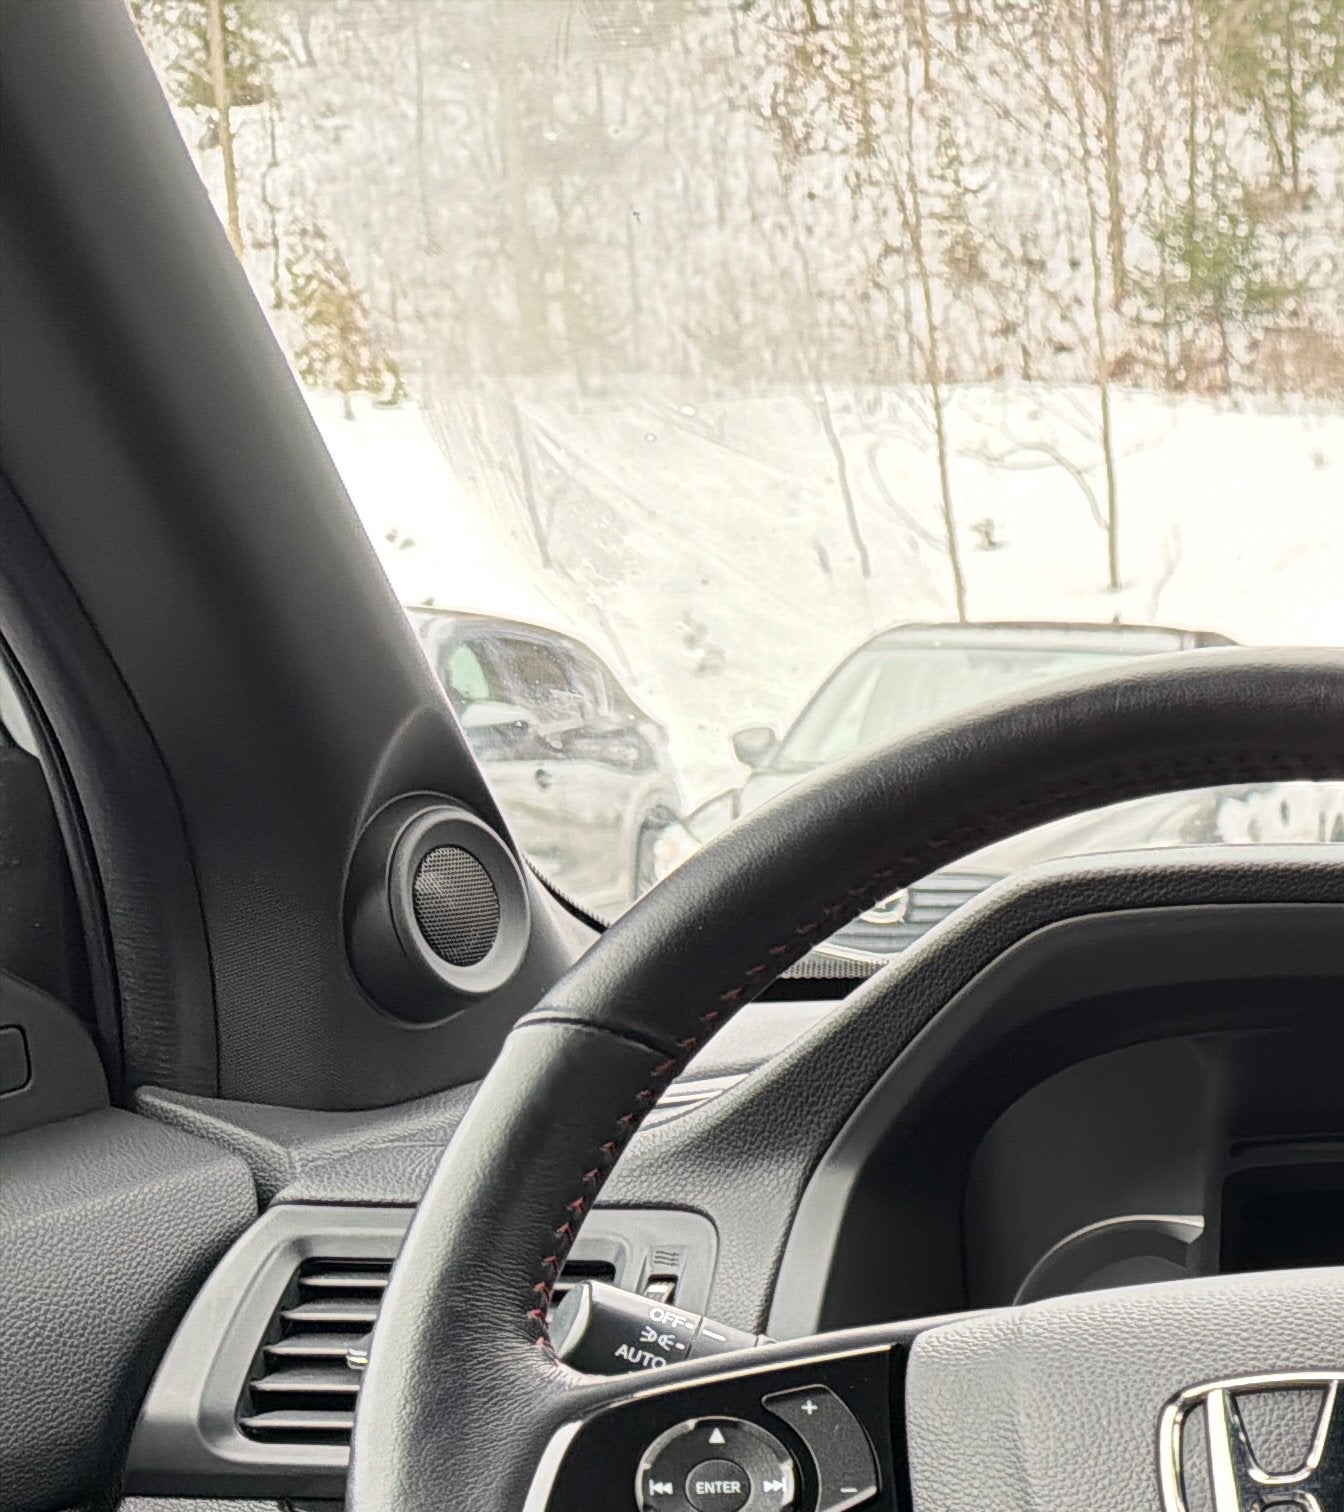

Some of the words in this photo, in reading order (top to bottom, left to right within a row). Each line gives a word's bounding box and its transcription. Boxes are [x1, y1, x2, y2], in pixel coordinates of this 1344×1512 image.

[649, 1307, 688, 1329] OFF
[614, 1343, 668, 1370] AUTO
[695, 1480, 741, 1495] ENTER
